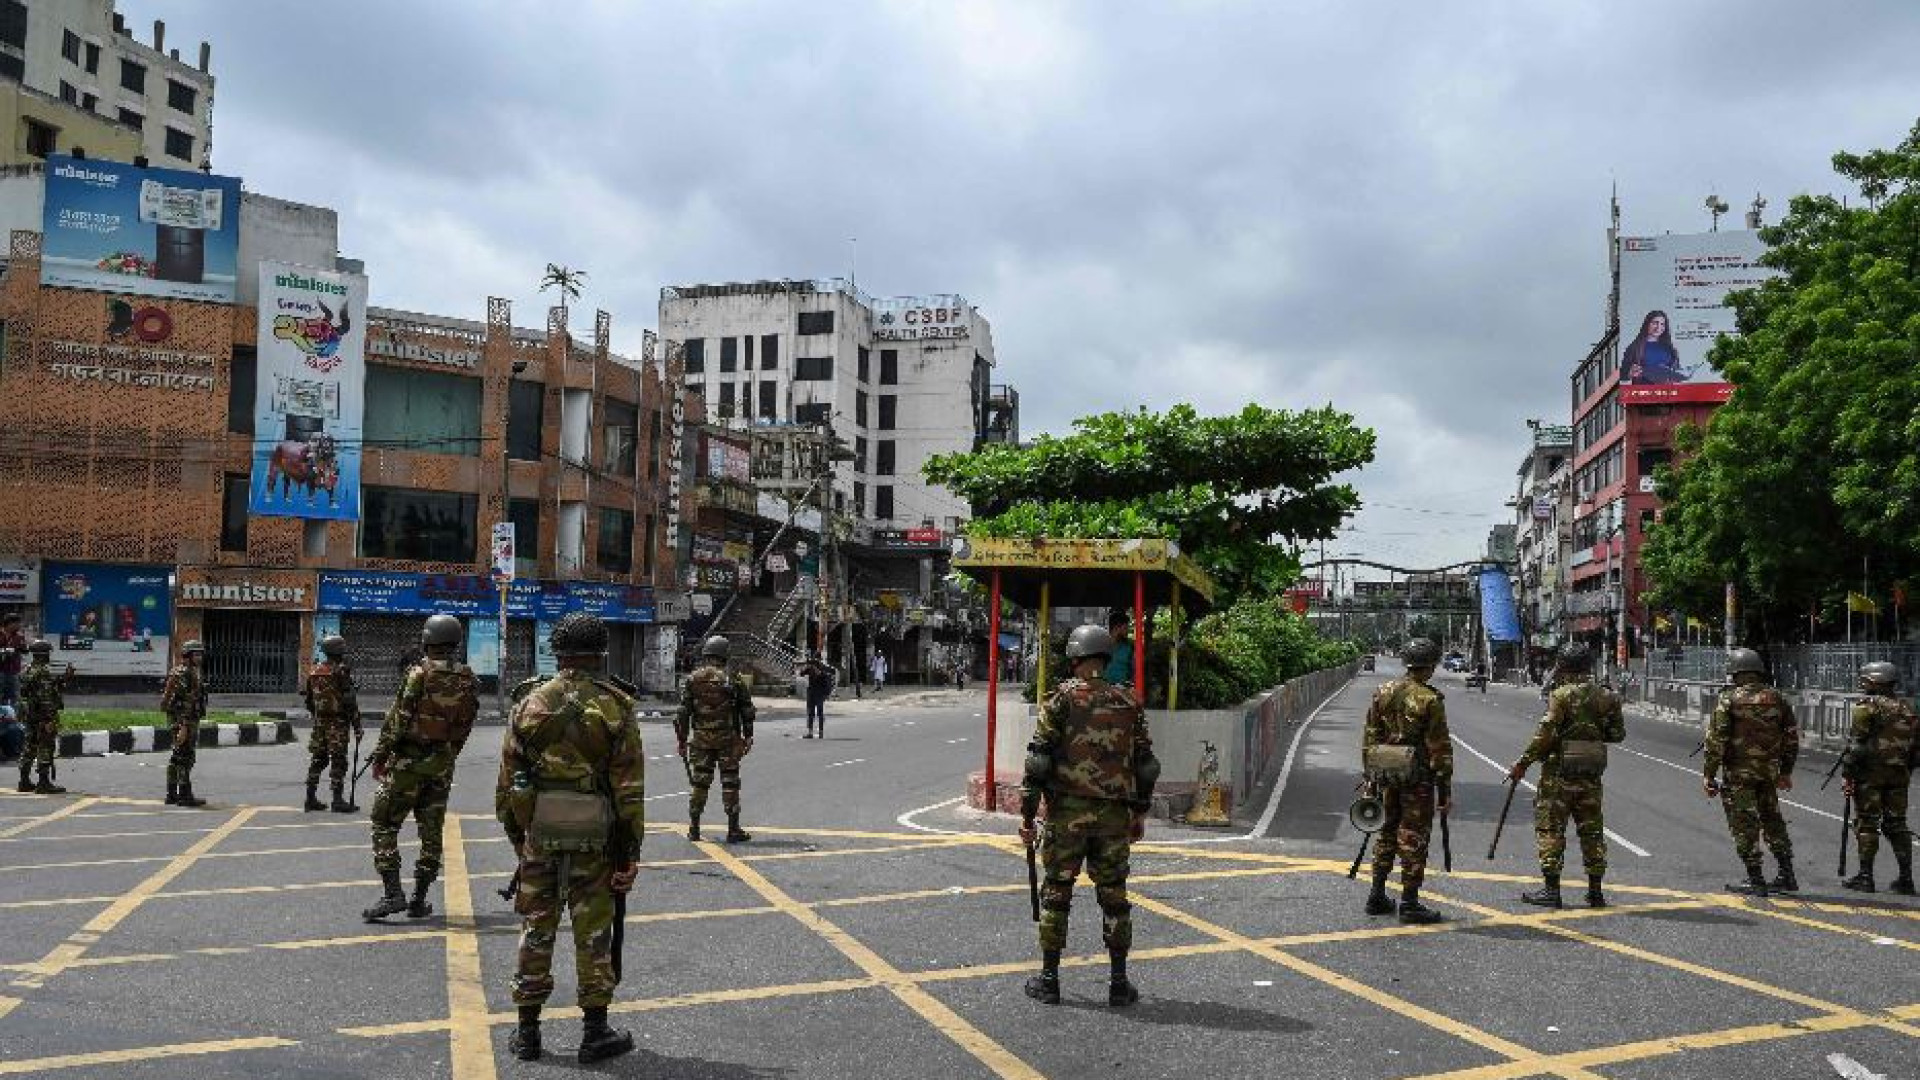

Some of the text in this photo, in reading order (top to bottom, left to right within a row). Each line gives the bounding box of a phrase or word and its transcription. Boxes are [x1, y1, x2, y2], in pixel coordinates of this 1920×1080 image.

[905, 308, 961, 325] CSBF
[872, 325, 970, 341] HEALTH CENTER
[366, 338, 483, 368] minister
[183, 581, 305, 603] minister
